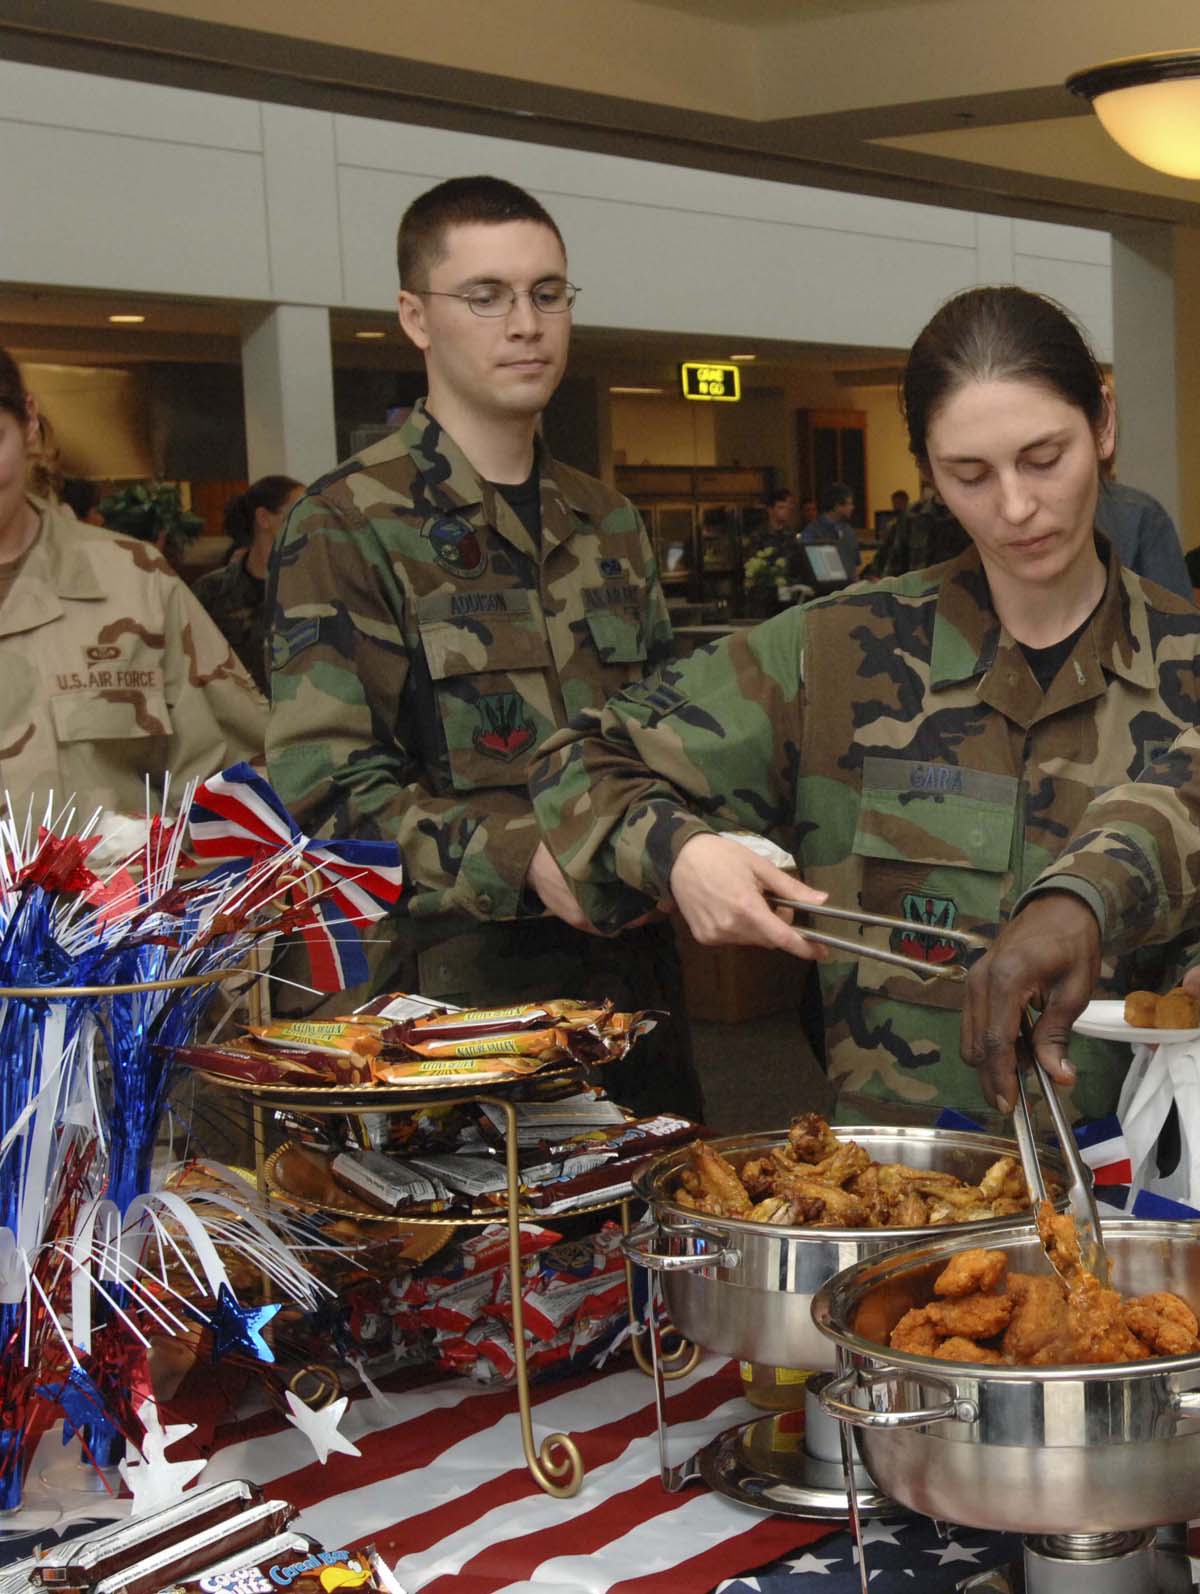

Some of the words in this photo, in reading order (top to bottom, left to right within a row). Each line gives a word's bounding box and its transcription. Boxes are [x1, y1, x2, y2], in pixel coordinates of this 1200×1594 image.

[56, 673, 87, 690] U.S.
[89, 671, 112, 688] AIR
[116, 670, 156, 687] FORCE
[456, 1044, 485, 1057] NATURE
[486, 1040, 515, 1053] VALLEY
[269, 1553, 322, 1586] Cereal
[317, 1550, 351, 1566] Bar
[200, 1567, 261, 1592] Cocoa
